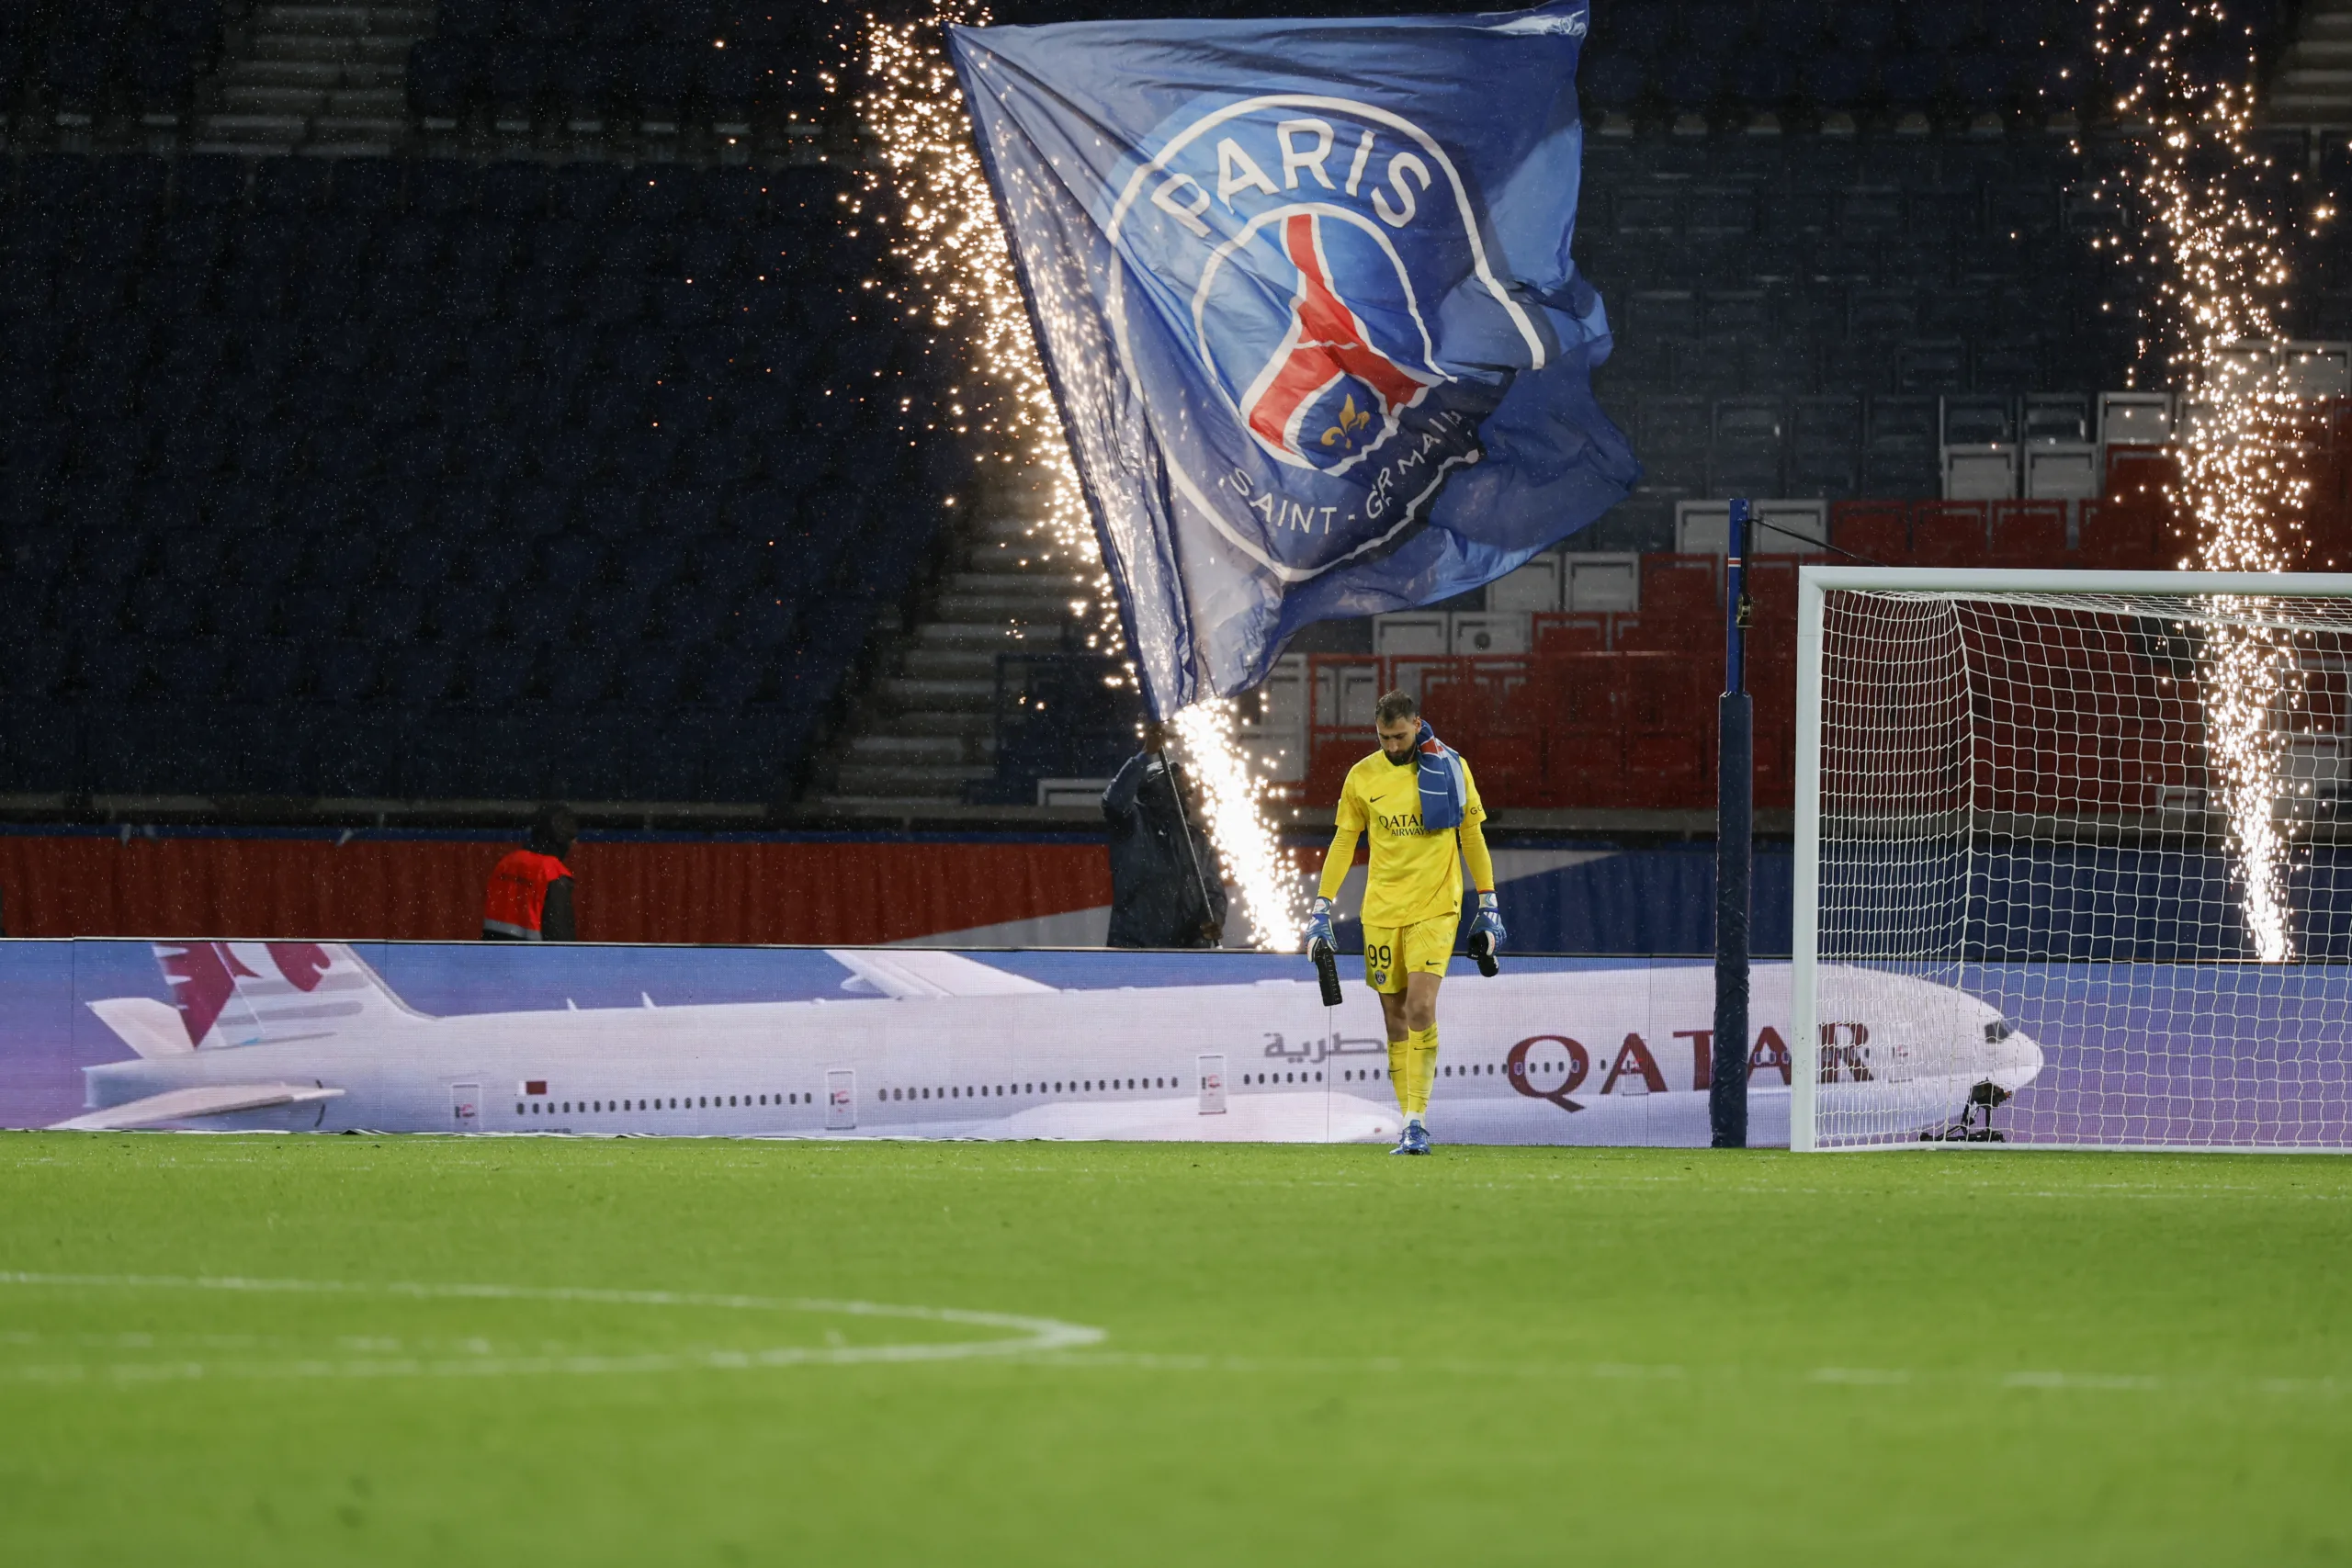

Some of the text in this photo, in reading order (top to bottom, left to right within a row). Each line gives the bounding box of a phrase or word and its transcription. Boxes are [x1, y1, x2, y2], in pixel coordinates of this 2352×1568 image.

[1150, 118, 1431, 238] PARIS
[1367, 943, 1392, 969] 99
[1507, 1021, 1874, 1113] QATAR
